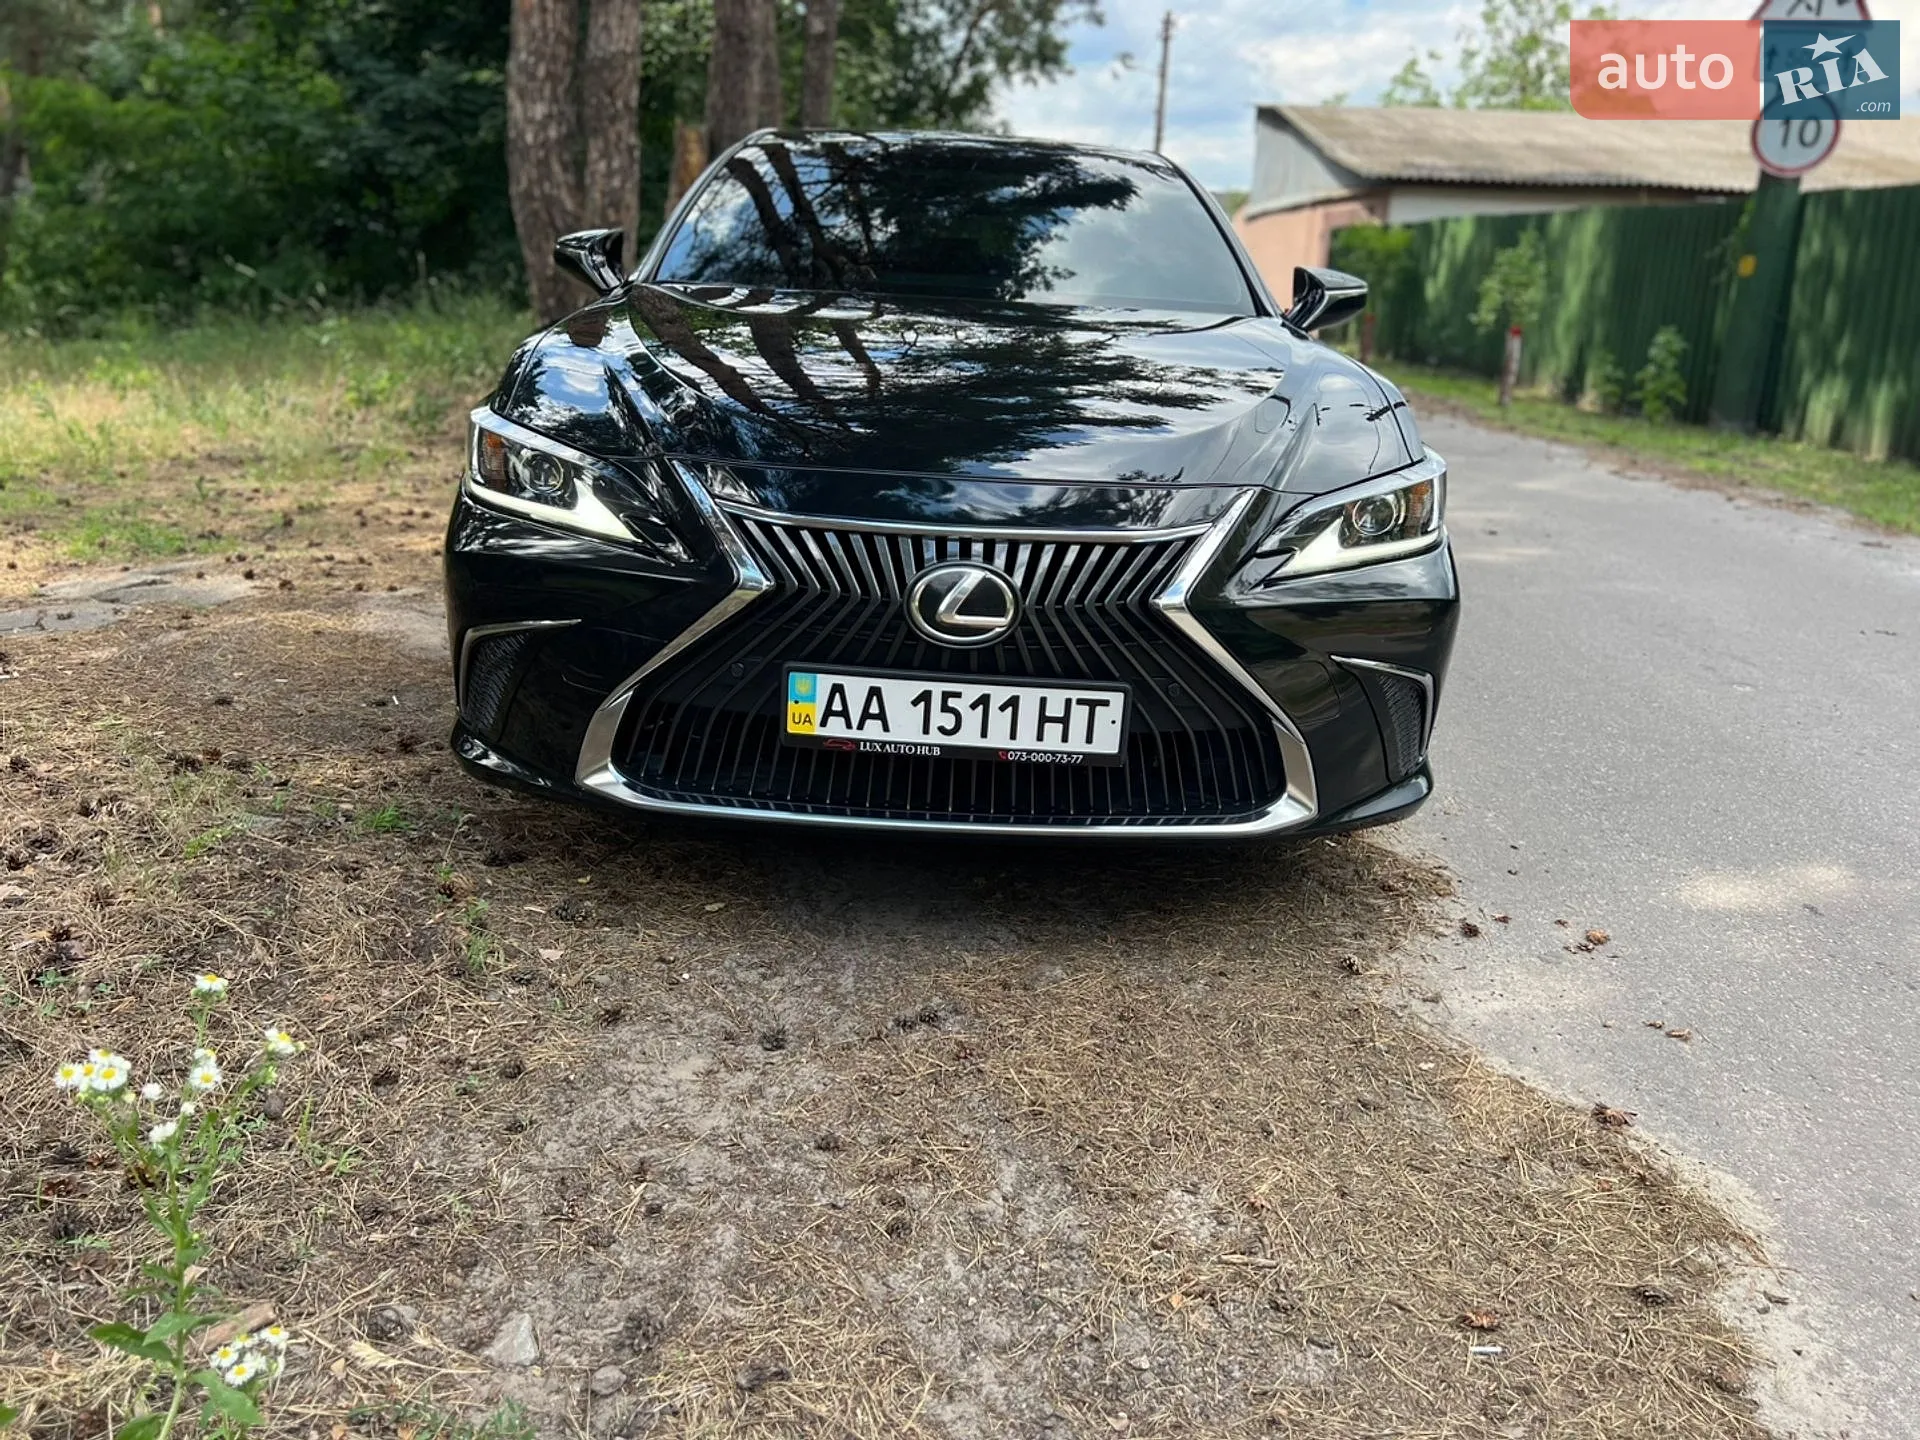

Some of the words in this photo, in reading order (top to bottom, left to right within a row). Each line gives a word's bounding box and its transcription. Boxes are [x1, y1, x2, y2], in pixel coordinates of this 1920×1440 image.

[1779, 115, 1823, 148] 10
[792, 712, 813, 726] UA
[819, 683, 891, 733] AA
[910, 689, 1021, 741] 1511
[1036, 696, 1111, 745] HT
[859, 741, 882, 752] LUX
[883, 743, 915, 755] AUTO
[916, 745, 941, 756] HUB
[1007, 751, 1083, 764] 073-000-73-77
